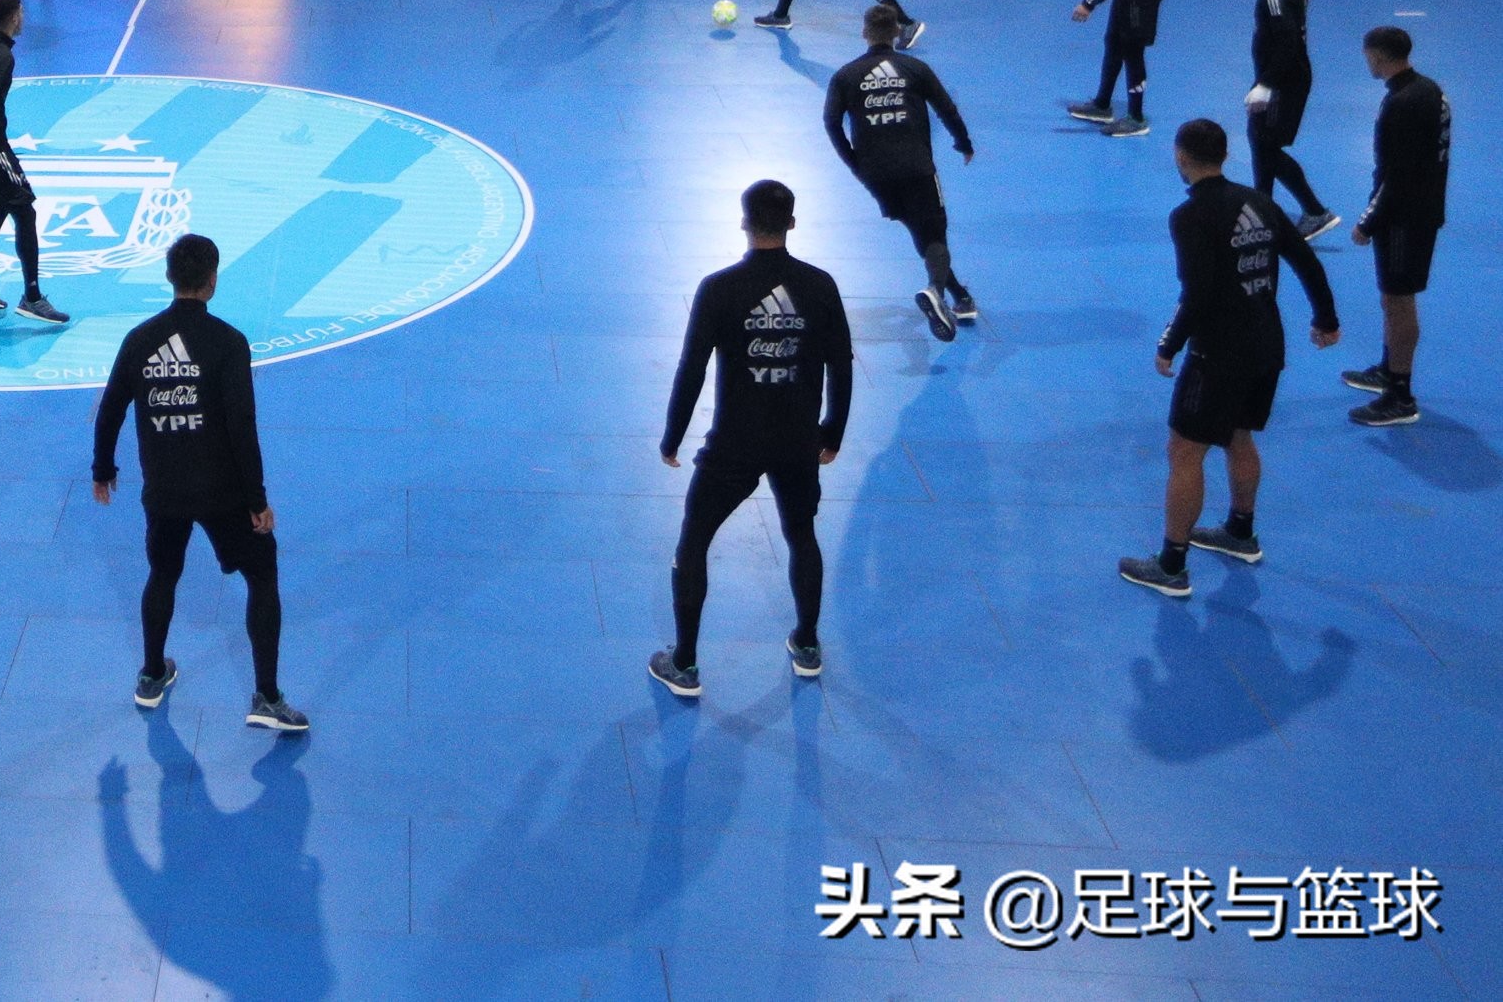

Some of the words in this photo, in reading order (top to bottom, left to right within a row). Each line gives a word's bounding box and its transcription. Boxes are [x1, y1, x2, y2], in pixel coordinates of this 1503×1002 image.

[859, 78, 906, 91] adidas
[865, 111, 907, 126] YPF
[339, 303, 396, 326] DEL
[744, 314, 806, 330] adidas
[250, 321, 346, 354] FÚTBO
[142, 361, 201, 379] adidas
[748, 365, 798, 384] YPF
[150, 413, 203, 432] YPF
